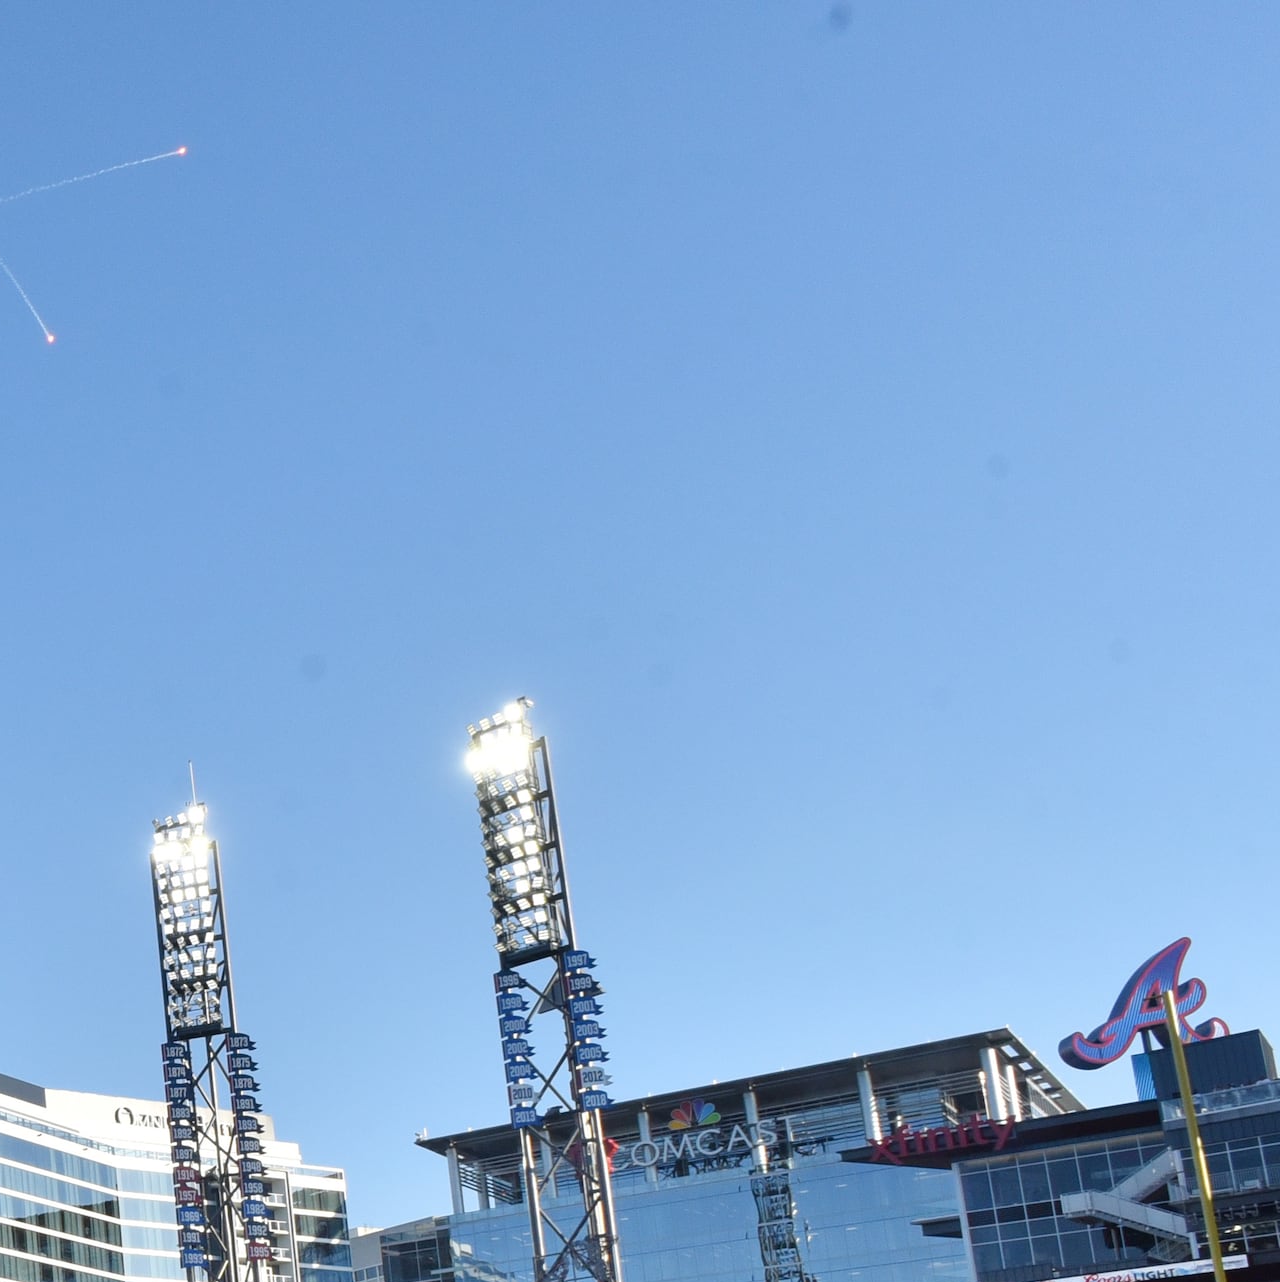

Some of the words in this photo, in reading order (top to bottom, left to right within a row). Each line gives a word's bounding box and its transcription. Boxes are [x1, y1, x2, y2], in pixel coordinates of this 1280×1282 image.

[567, 954, 587, 967] 1997
[499, 975, 519, 986] 1996
[570, 977, 591, 990] 1999
[502, 998, 522, 1010] 1998
[574, 1000, 595, 1013] 2001
[504, 1020, 524, 1032] 2000
[577, 1024, 598, 1036] 2003
[230, 1037, 248, 1048] 1873
[166, 1047, 184, 1057] 1872
[507, 1043, 528, 1054] 2002
[580, 1047, 601, 1059] 2005
[232, 1058, 250, 1068] 1875
[168, 1067, 185, 1077] 1874
[510, 1065, 531, 1077] 2004
[583, 1070, 604, 1083] 2012
[234, 1078, 252, 1089] 1878
[170, 1087, 187, 1098] 1877
[512, 1087, 533, 1099] 2010
[236, 1099, 253, 1109] 1891
[586, 1093, 607, 1106] 2018
[171, 1108, 190, 1118] 1883
[515, 1110, 536, 1123] 2013
[238, 1120, 256, 1130] 1893
[173, 1128, 191, 1139] 1892
[868, 1113, 1016, 1164] xfinity
[240, 1141, 258, 1151] 1898
[612, 1115, 798, 1171] COMCAST
[175, 1149, 192, 1160] 1897
[242, 1161, 261, 1172] 1948
[177, 1170, 194, 1180] 1914
[244, 1183, 263, 1194] 1958
[178, 1190, 196, 1200] 1957
[246, 1204, 265, 1214] 1982
[181, 1211, 199, 1222] 1969
[248, 1225, 267, 1236] 1992
[183, 1232, 200, 1243] 1991
[250, 1246, 269, 1257] 1995
[184, 1253, 203, 1264] 1993
[1133, 1267, 1177, 1281] LIGHT
